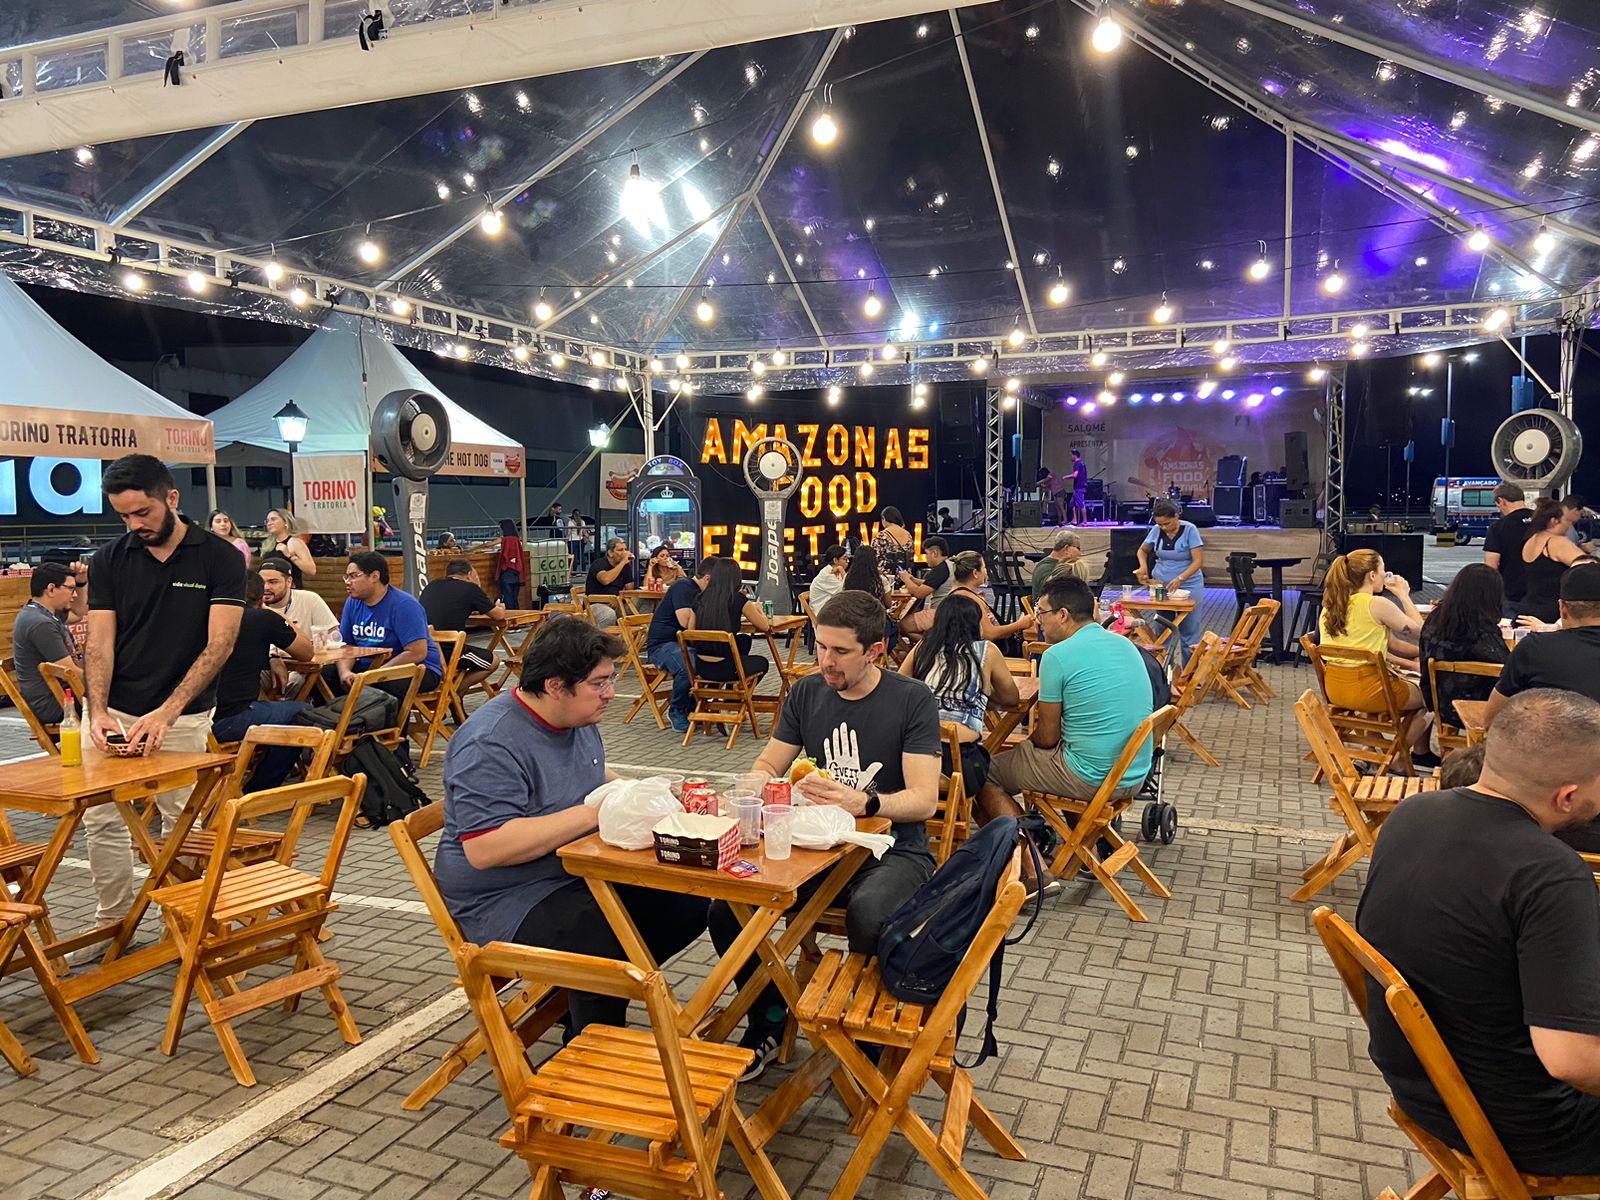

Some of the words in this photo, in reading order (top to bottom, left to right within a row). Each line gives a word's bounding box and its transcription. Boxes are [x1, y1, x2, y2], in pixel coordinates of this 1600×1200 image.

[1067, 422, 1106, 433] SALOMÉ
[56, 424, 138, 448] TRATORIA
[165, 428, 208, 446] TORINO
[457, 452, 472, 467] HOT
[474, 453, 488, 468] DOG
[647, 458, 662, 468] TOY
[668, 458, 684, 468] BOX
[1163, 472, 1204, 482] FOOD
[303, 480, 357, 501] TORINO
[313, 501, 347, 509] TRATORIA
[413, 521, 429, 596] oape
[766, 520, 780, 586] Joape
[541, 559, 565, 571] ECO
[543, 575, 565, 586] ART
[352, 621, 385, 637] sidia
